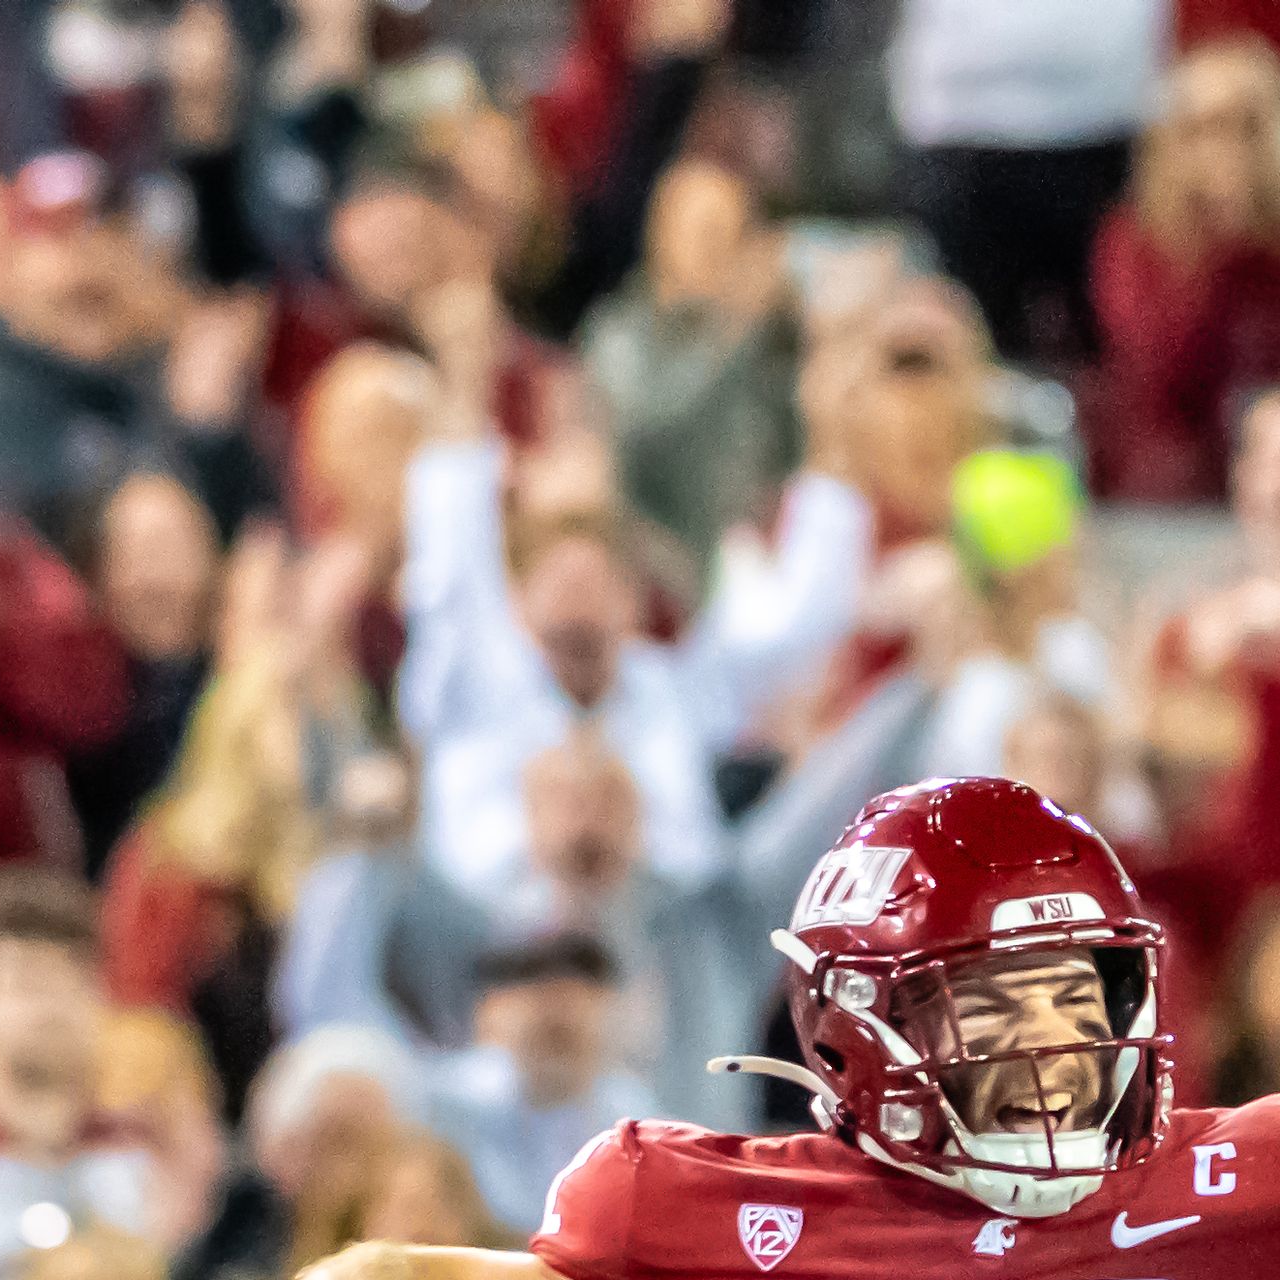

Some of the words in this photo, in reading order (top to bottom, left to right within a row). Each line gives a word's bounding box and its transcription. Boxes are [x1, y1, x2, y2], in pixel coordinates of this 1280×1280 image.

[1026, 896, 1072, 921] WSU
[1191, 1141, 1237, 1196] C
[753, 1230, 785, 1256] 12
